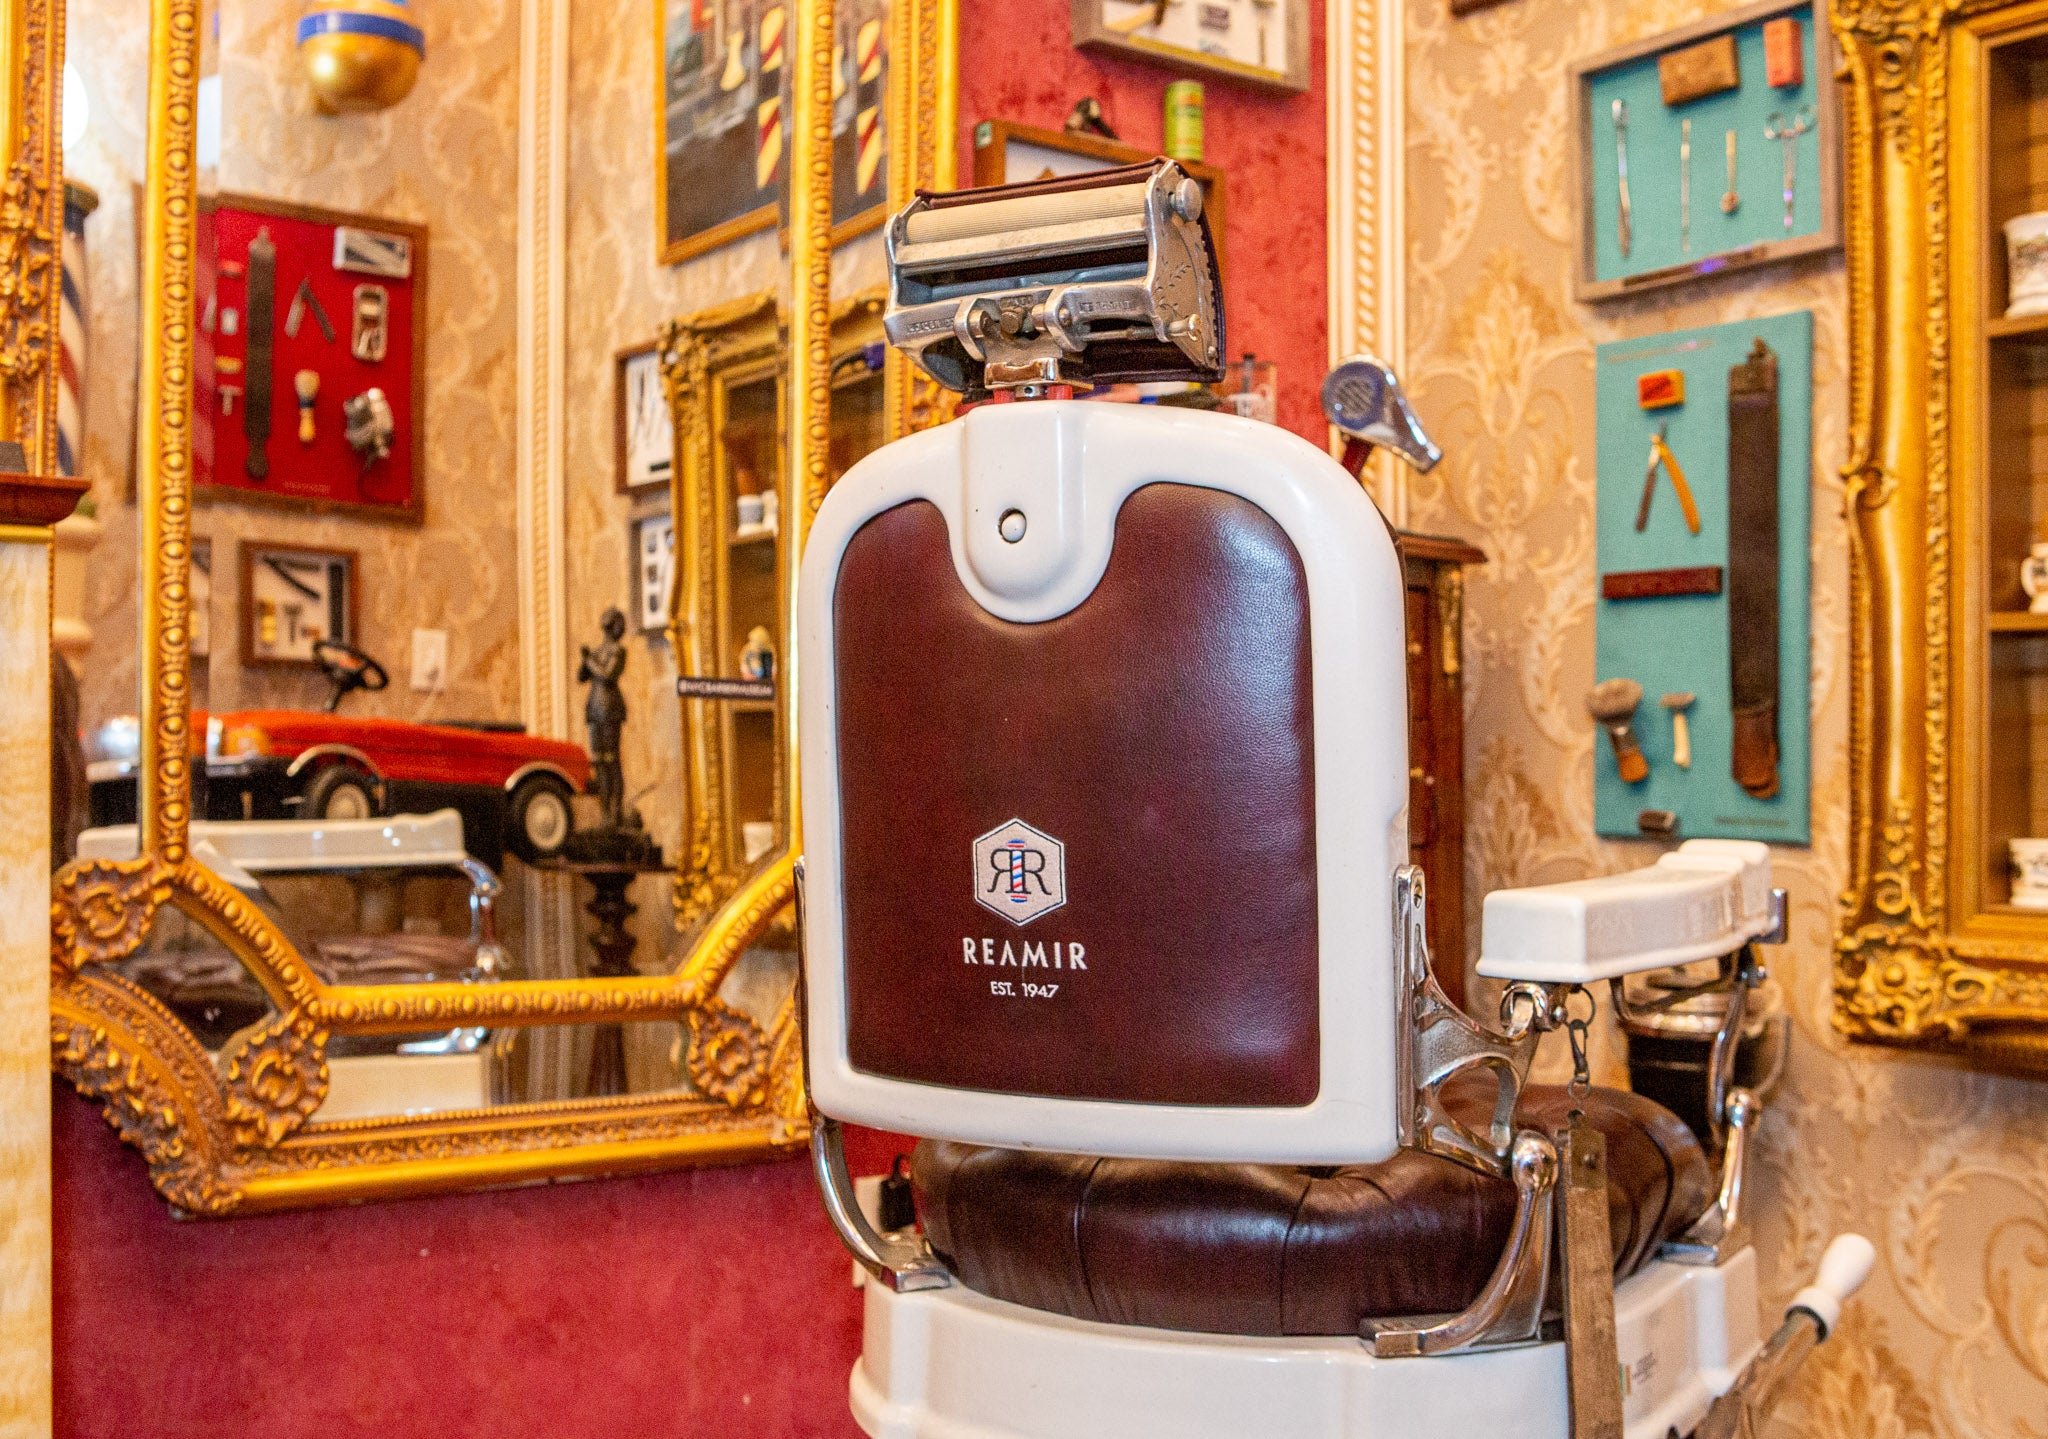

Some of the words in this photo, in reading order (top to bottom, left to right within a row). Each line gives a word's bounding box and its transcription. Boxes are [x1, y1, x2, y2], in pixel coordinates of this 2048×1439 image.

[962, 937, 1087, 970] REAMIR
[990, 981, 1015, 996] EST.
[1021, 982, 1059, 998] 1947
